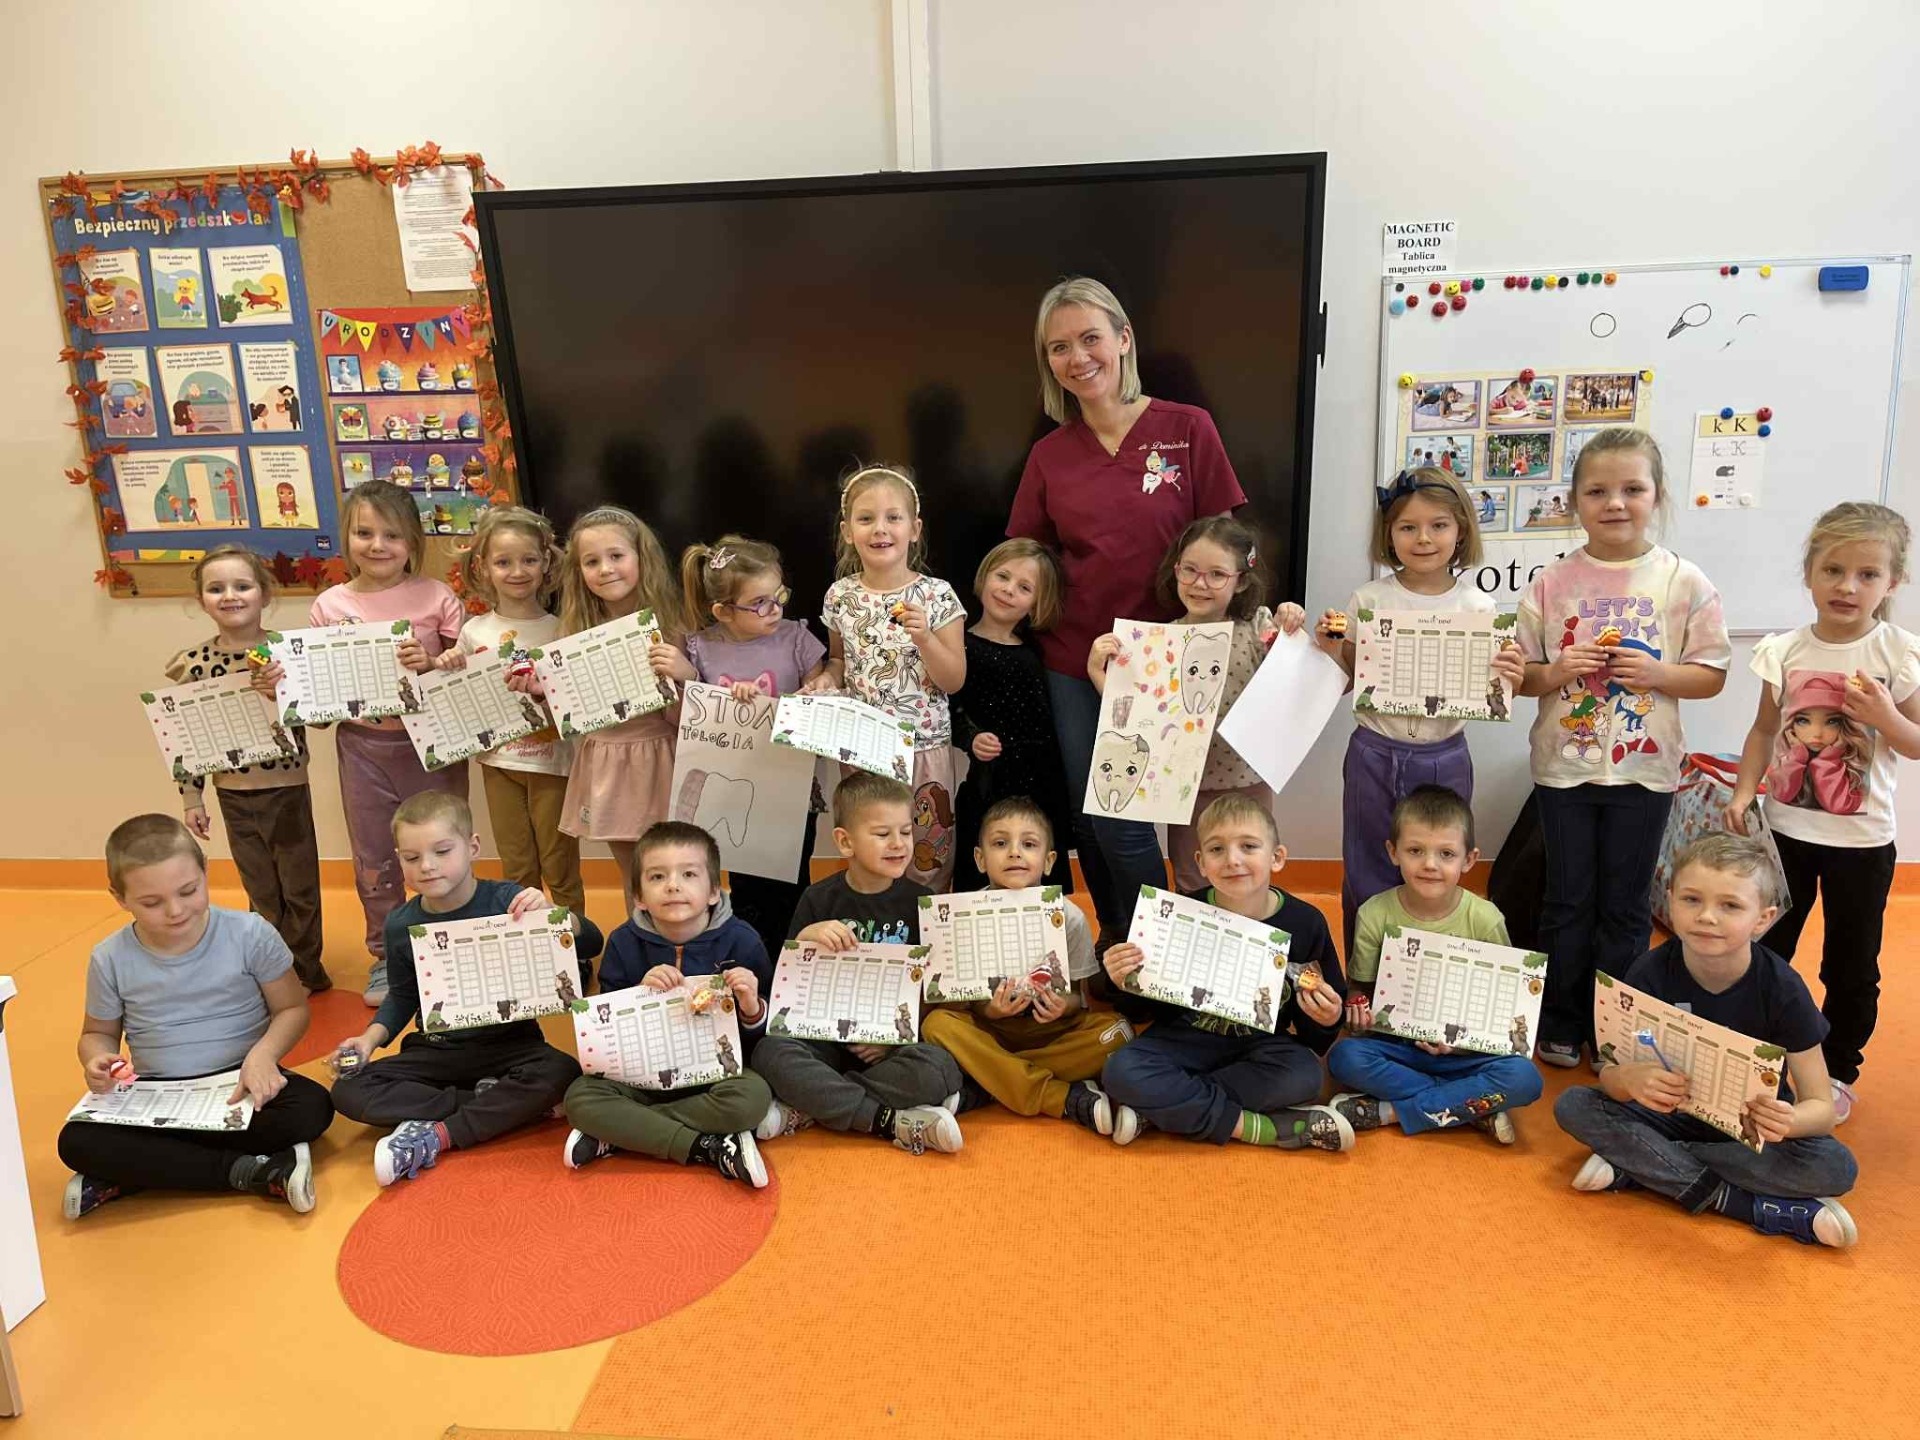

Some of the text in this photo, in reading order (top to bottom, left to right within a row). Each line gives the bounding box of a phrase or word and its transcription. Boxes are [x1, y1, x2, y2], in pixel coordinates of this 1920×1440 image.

[75, 216, 160, 238] Bezpieczny
[1387, 222, 1454, 234] MAGNETIC
[1397, 237, 1441, 248] BOARD
[1401, 251, 1435, 260] Tablica
[1388, 265, 1447, 274] magnetyczna
[324, 314, 464, 338] URODZINY
[1713, 417, 1748, 433] k K
[1579, 597, 1654, 618] LET'S
[680, 725, 754, 750] TOLOGIA
